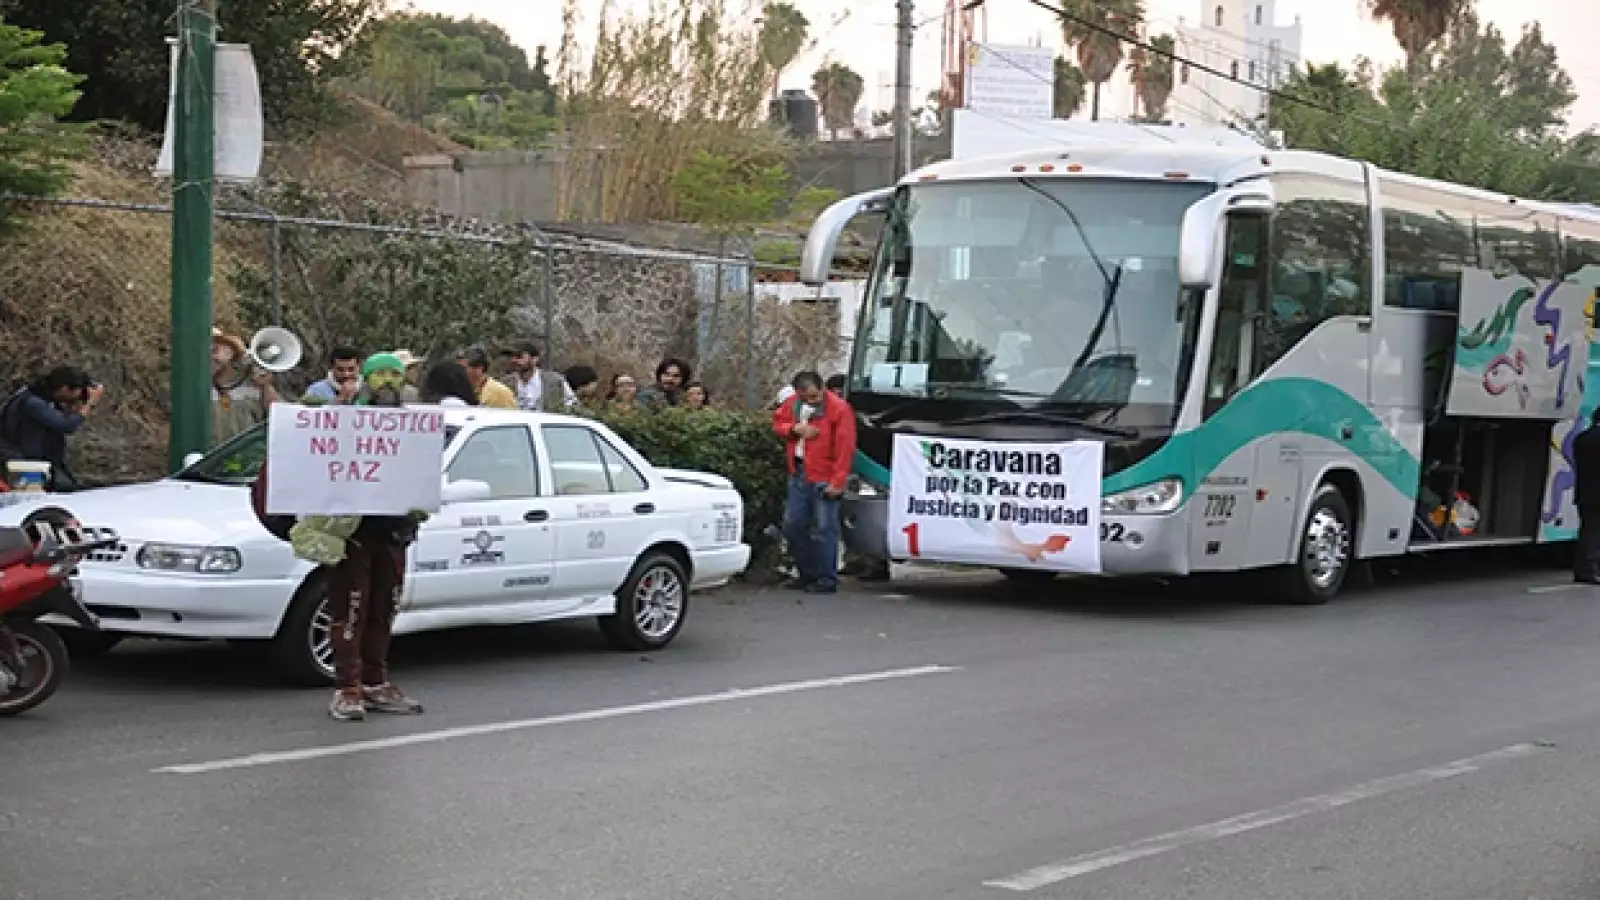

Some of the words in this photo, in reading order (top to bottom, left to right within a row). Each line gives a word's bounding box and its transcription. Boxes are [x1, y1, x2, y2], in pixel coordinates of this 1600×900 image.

[892, 366, 903, 388] 1
[295, 410, 340, 431] SIN
[309, 436, 339, 455] NO
[356, 436, 401, 456] HAY
[930, 442, 1062, 475] Caravana
[328, 460, 381, 482] PAZ
[926, 475, 959, 494] por
[963, 474, 983, 494] la
[987, 476, 1019, 496] Paz
[1025, 480, 1066, 500] con
[907, 494, 980, 519] Justicia
[984, 503, 995, 521] y
[999, 501, 1088, 526] Dignidad
[902, 522, 920, 556] 1
